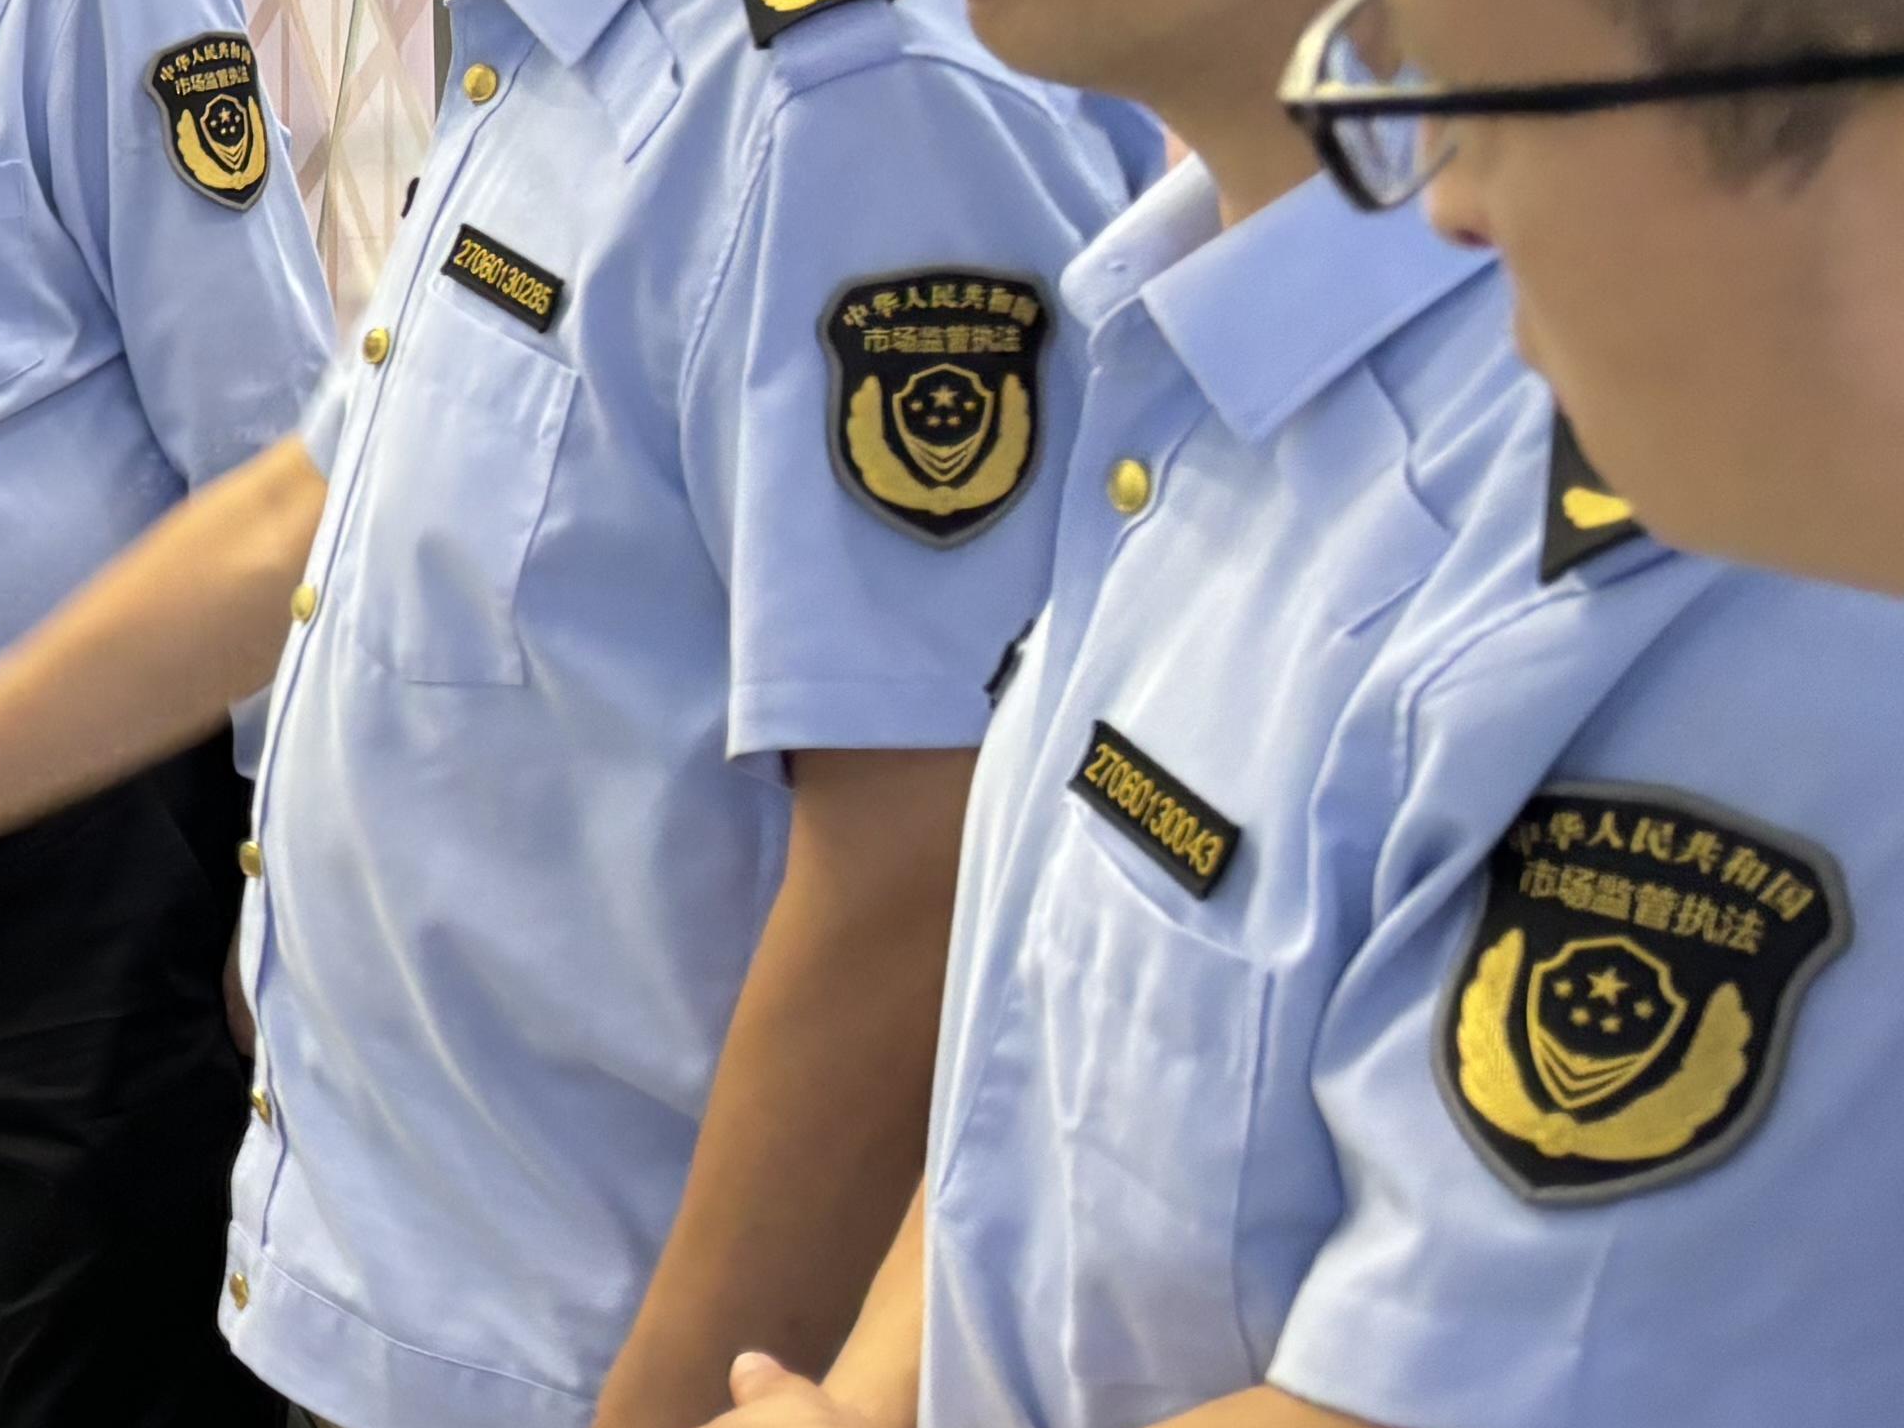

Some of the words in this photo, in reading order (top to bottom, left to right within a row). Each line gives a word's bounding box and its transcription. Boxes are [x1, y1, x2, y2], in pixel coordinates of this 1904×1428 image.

[453, 238, 554, 316] 27060130285
[1083, 742, 1224, 876] 27060130043
[1509, 810, 1816, 922] 中华人民共和国
[1519, 857, 1769, 956] 市场监管执法
